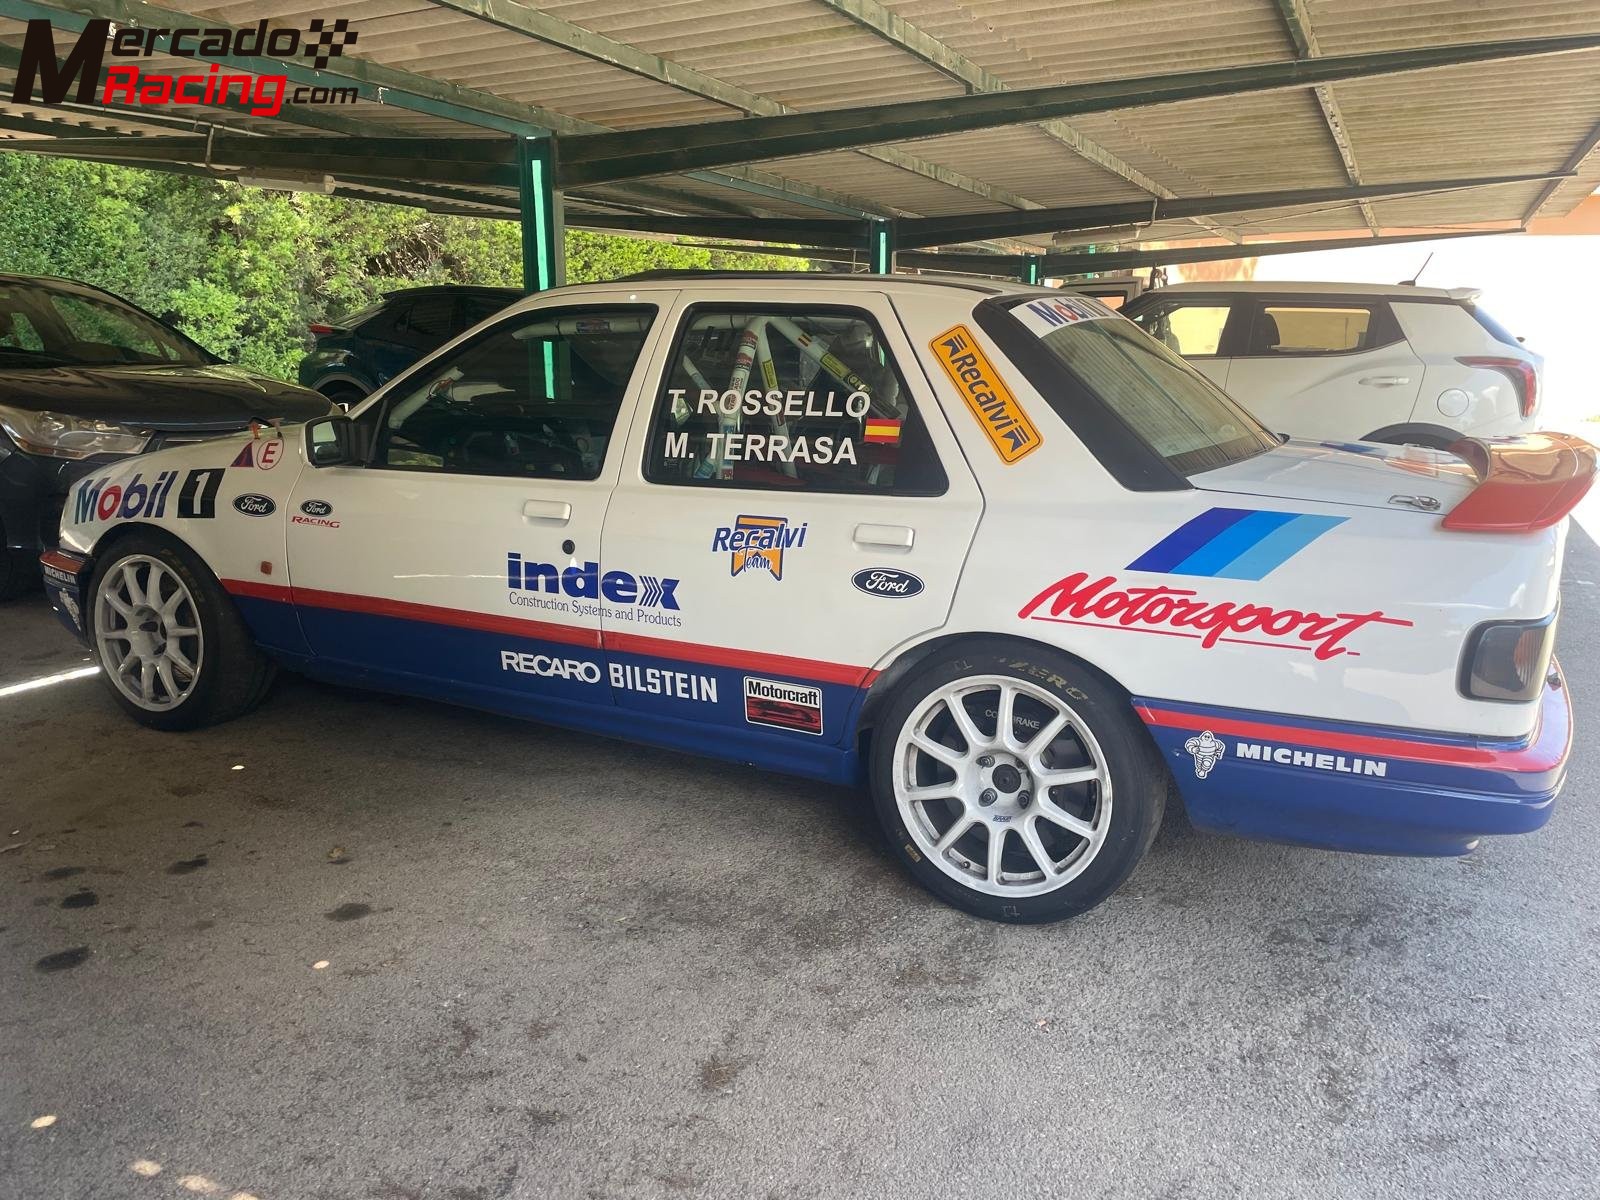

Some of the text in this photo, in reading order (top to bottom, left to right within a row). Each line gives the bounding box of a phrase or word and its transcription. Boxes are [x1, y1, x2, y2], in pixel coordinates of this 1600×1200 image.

[697, 384, 871, 418] ROSSELLÓ
[951, 351, 1019, 432] Recalvi
[261, 442, 279, 464] E
[663, 432, 858, 465] M. TERRASA
[74, 471, 180, 525] Mobil
[291, 515, 341, 529] RACING
[711, 522, 808, 553] Recalvi
[43, 565, 77, 585] MICHELIN
[737, 546, 773, 573] Team
[507, 552, 681, 611] index
[509, 591, 682, 628] Construction Systems and Products
[1018, 572, 1414, 661] Motorsport
[500, 650, 601, 684] RECARO
[608, 662, 719, 704] BILSTEIN
[748, 680, 818, 706] Motorcraft
[1236, 742, 1388, 778] MICHELIN
